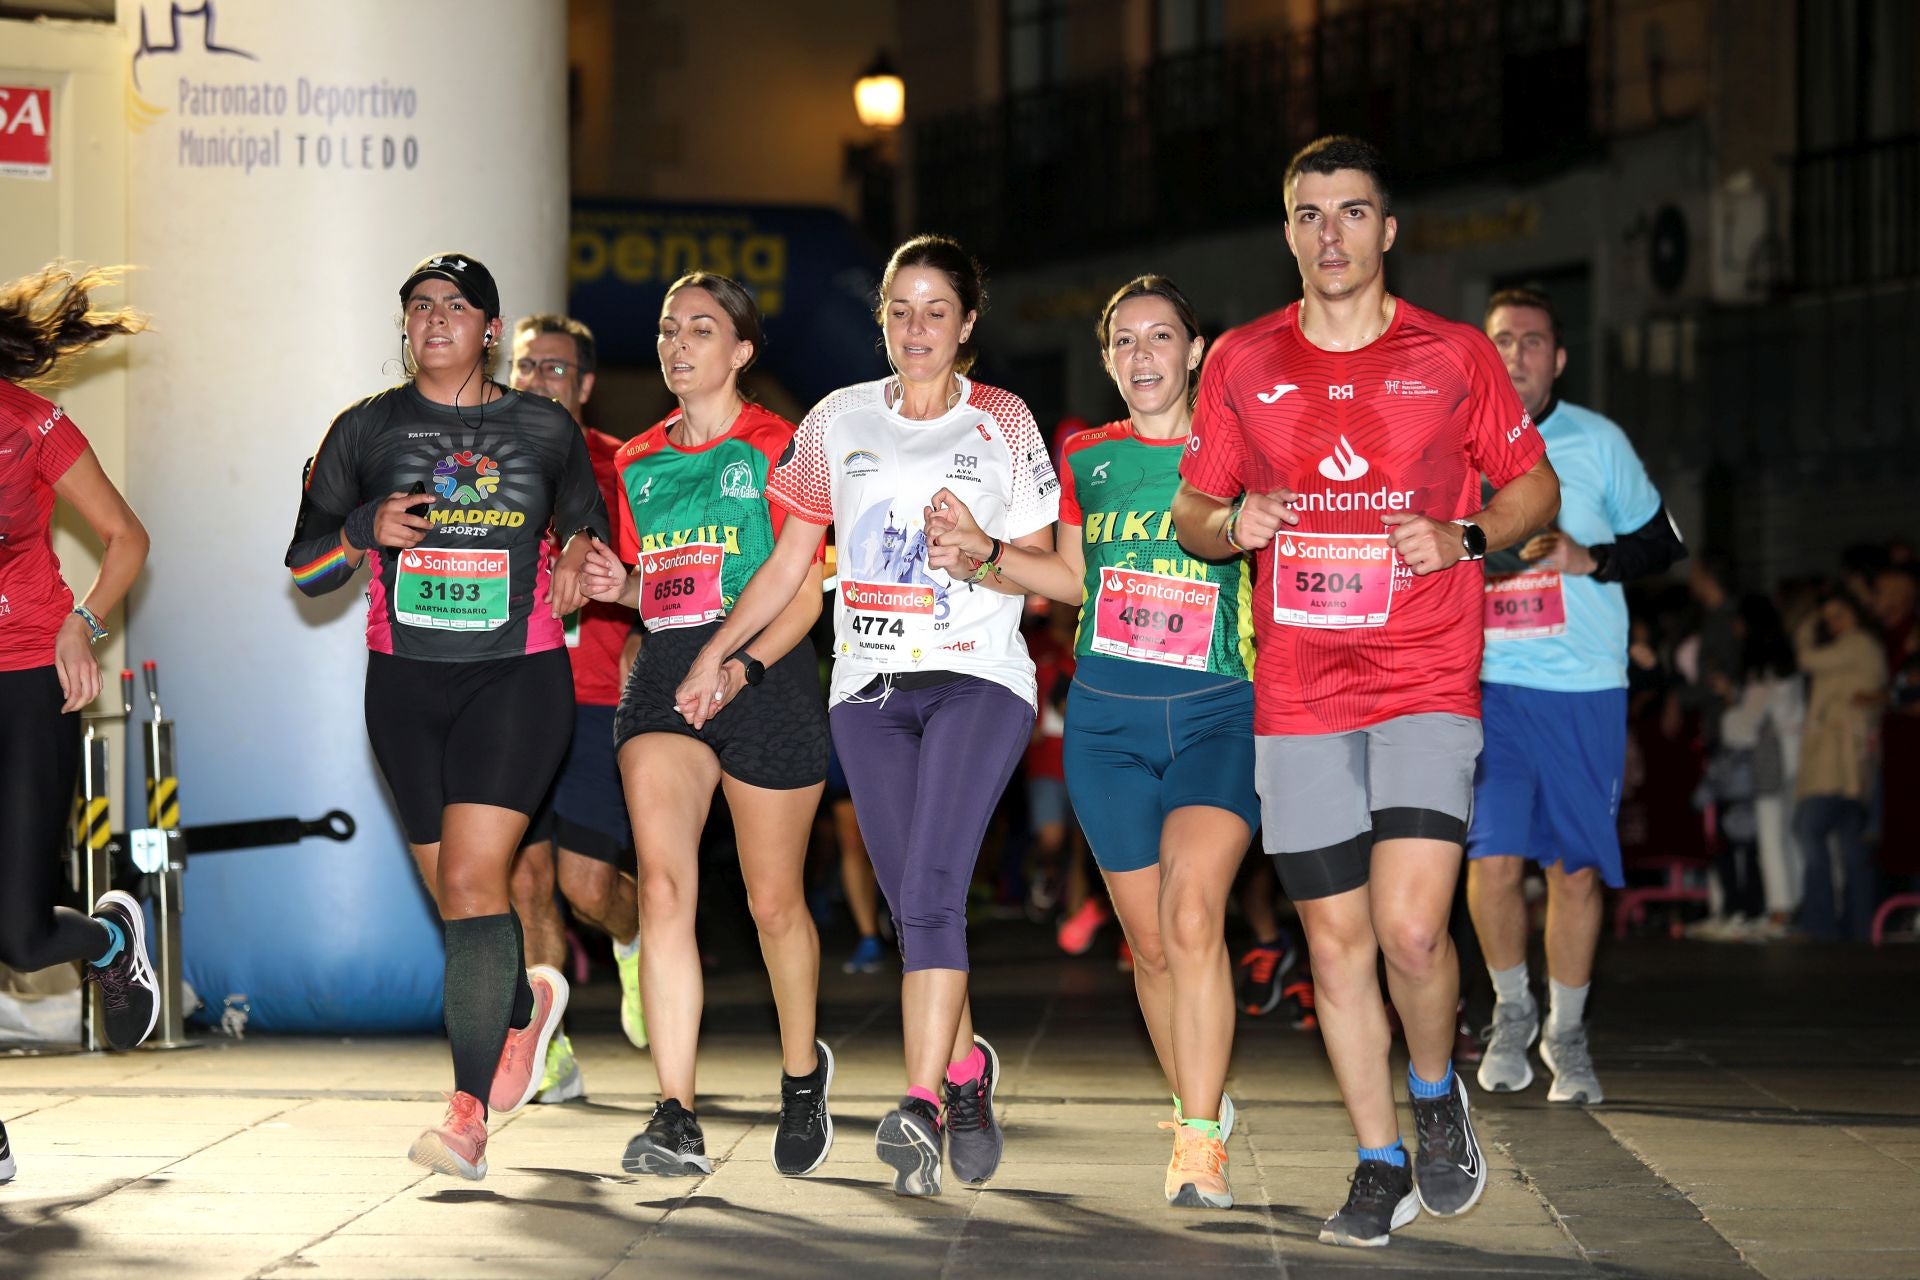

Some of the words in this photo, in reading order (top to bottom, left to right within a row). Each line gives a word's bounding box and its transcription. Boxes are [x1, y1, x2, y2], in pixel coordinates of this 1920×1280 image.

[178, 77, 288, 116] Patronato
[297, 77, 418, 125] Deportivo
[178, 129, 281, 175] Municipal
[295, 134, 419, 170] TOLEDO
[38, 418, 55, 436] La
[1507, 425, 1522, 444] La
[954, 474, 982, 484] MEZQUITA
[430, 509, 525, 528] MADRID
[1086, 511, 1178, 545] BIKI
[440, 526, 489, 537] SPORTS
[1298, 541, 1390, 560] Santander
[424, 555, 504, 572] Santander
[659, 549, 720, 572] Santander
[1153, 558, 1208, 583] RUN
[419, 580, 481, 601] 3193
[654, 576, 695, 601] 6558
[1295, 571, 1363, 593] 5204
[1393, 578, 1413, 592] 024
[854, 588, 927, 608] Santande
[1126, 578, 1212, 606] Santander
[415, 604, 449, 614] MARTHA
[450, 606, 487, 615] ROSARIO
[662, 603, 681, 612] LAURA
[1494, 597, 1544, 616] 5013
[852, 615, 905, 638] 4774
[934, 622, 950, 631] 019
[1119, 606, 1184, 634] 4890
